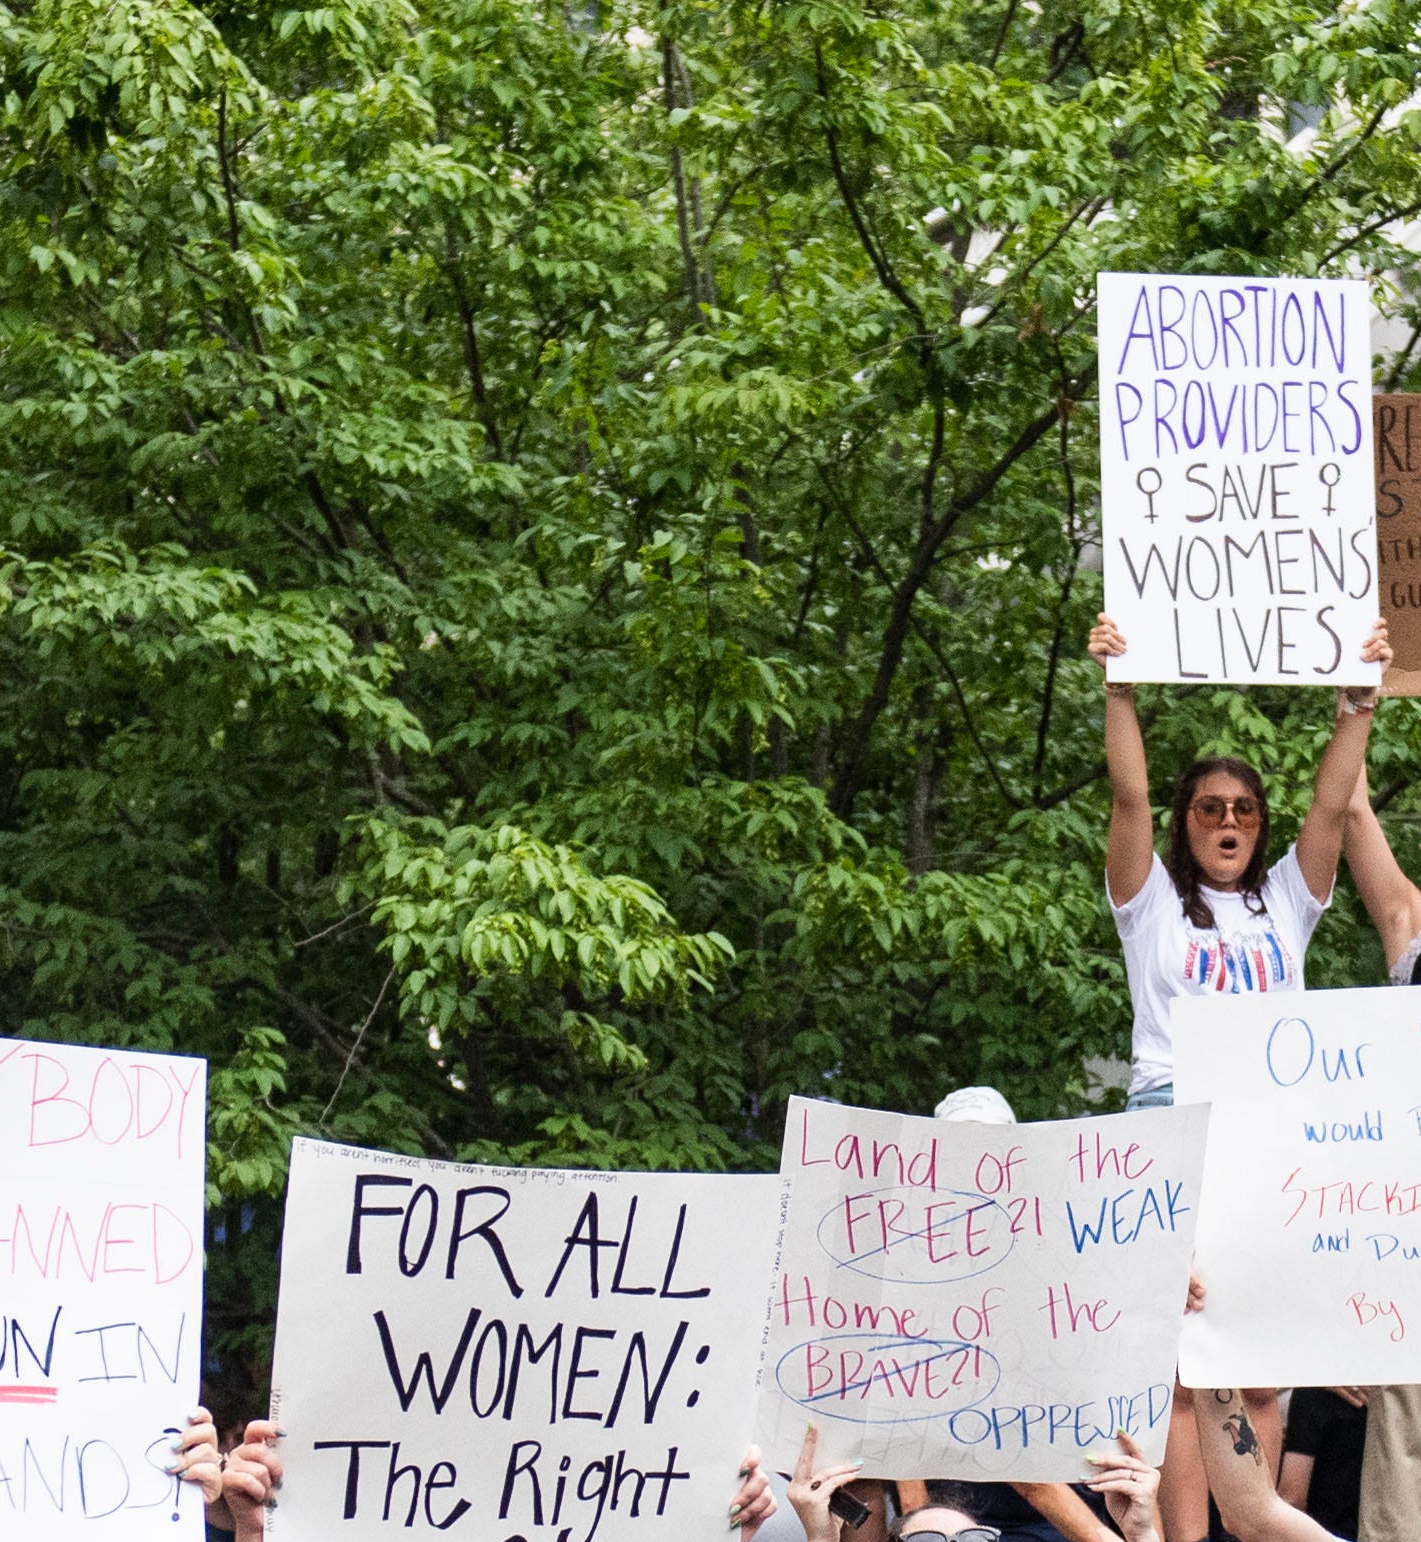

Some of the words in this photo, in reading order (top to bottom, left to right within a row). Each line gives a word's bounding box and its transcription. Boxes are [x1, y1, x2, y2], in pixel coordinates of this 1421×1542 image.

[1118, 286, 1346, 375] ABORTION
[1115, 378, 1363, 462] PROVIDERS
[1185, 462, 1300, 526] SAVE
[1173, 604, 1343, 682] LIVES
[1265, 1016, 1372, 1087] Our
[26, 1053, 201, 1162] BODY
[1303, 1109, 1383, 1144] would
[800, 1108, 938, 1193] Land
[974, 1145, 1028, 1194] of
[1068, 1131, 1154, 1184] the
[344, 1173, 524, 1300] FOR
[545, 1192, 711, 1302] ALL
[1065, 1178, 1191, 1254] WEAK
[774, 1272, 928, 1338] Home
[952, 1286, 1006, 1341] of
[1037, 1282, 1122, 1340] the
[1345, 1292, 1406, 1343] By
[73, 1311, 184, 1385] IN
[374, 1306, 711, 1430] WOMEN:
[313, 1439, 472, 1531] The
